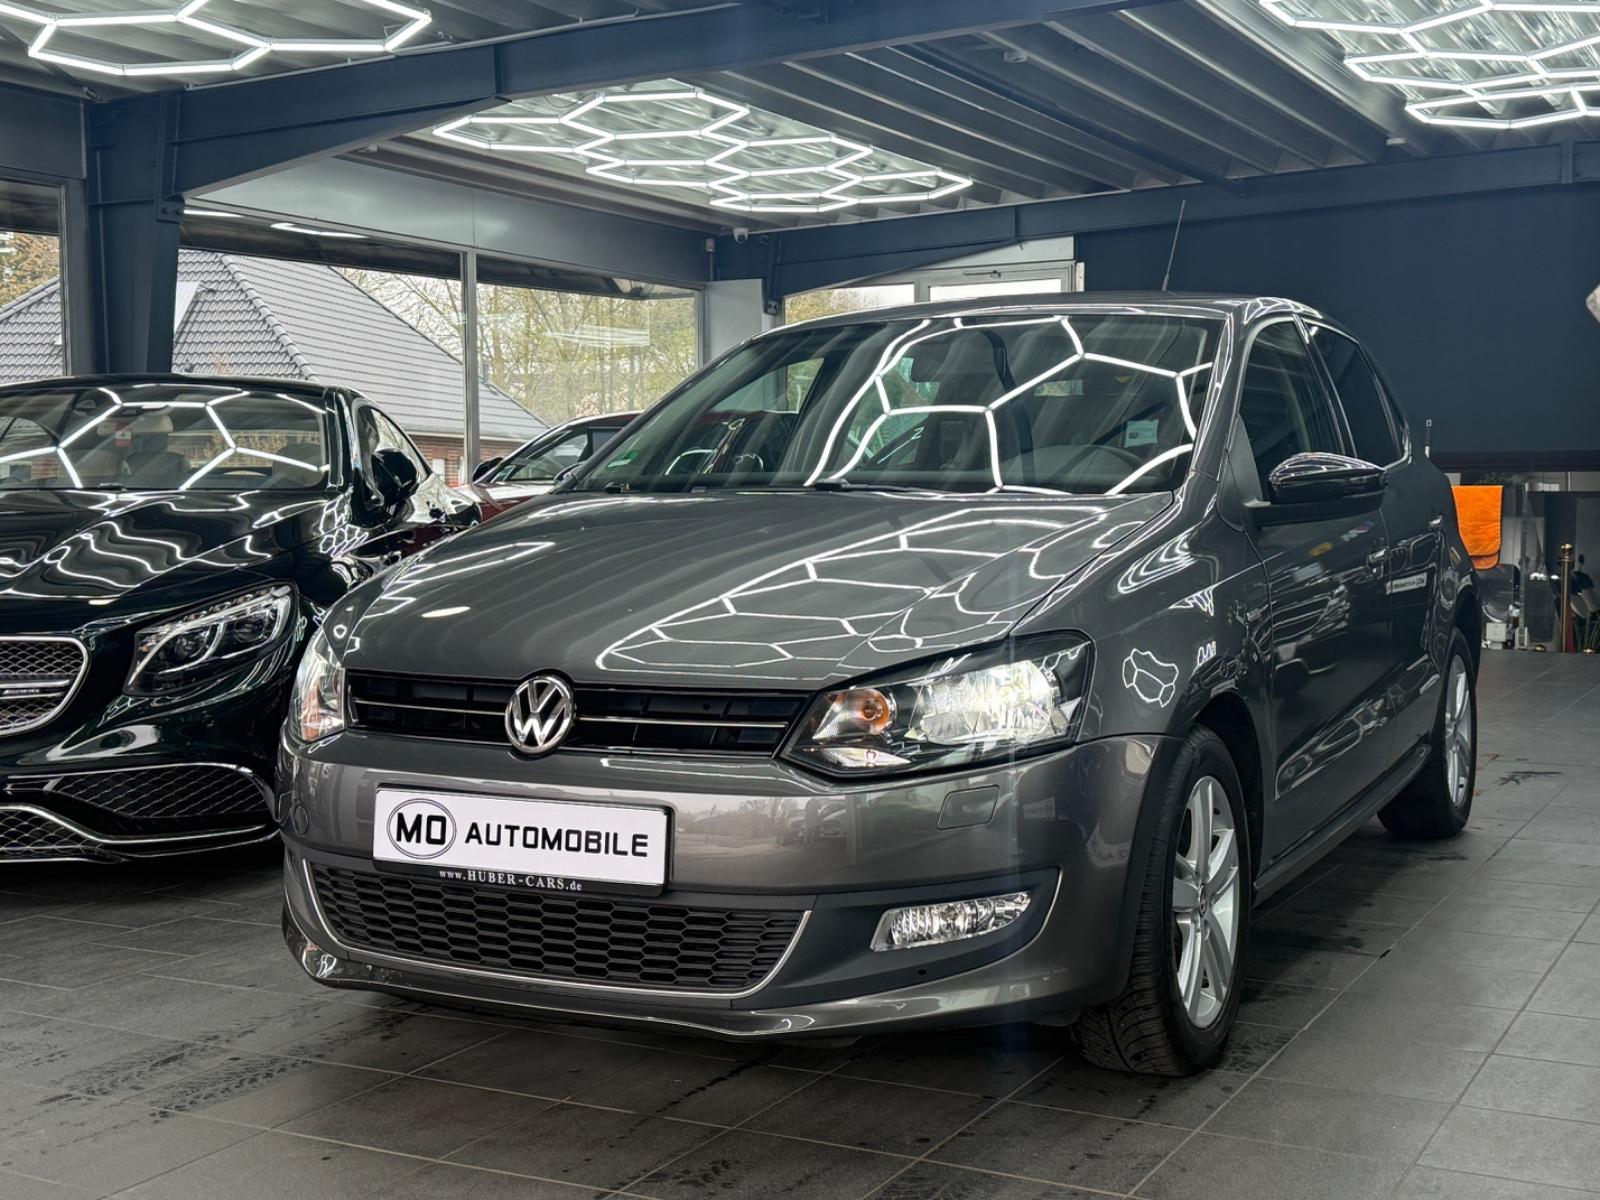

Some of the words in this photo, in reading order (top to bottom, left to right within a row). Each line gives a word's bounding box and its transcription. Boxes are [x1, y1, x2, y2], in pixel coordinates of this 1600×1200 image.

[508, 678, 572, 749] VW
[396, 812, 447, 846] MO
[464, 822, 649, 858] AUTOMOBILE
[439, 869, 583, 892] www.HUBER-CARS.de
